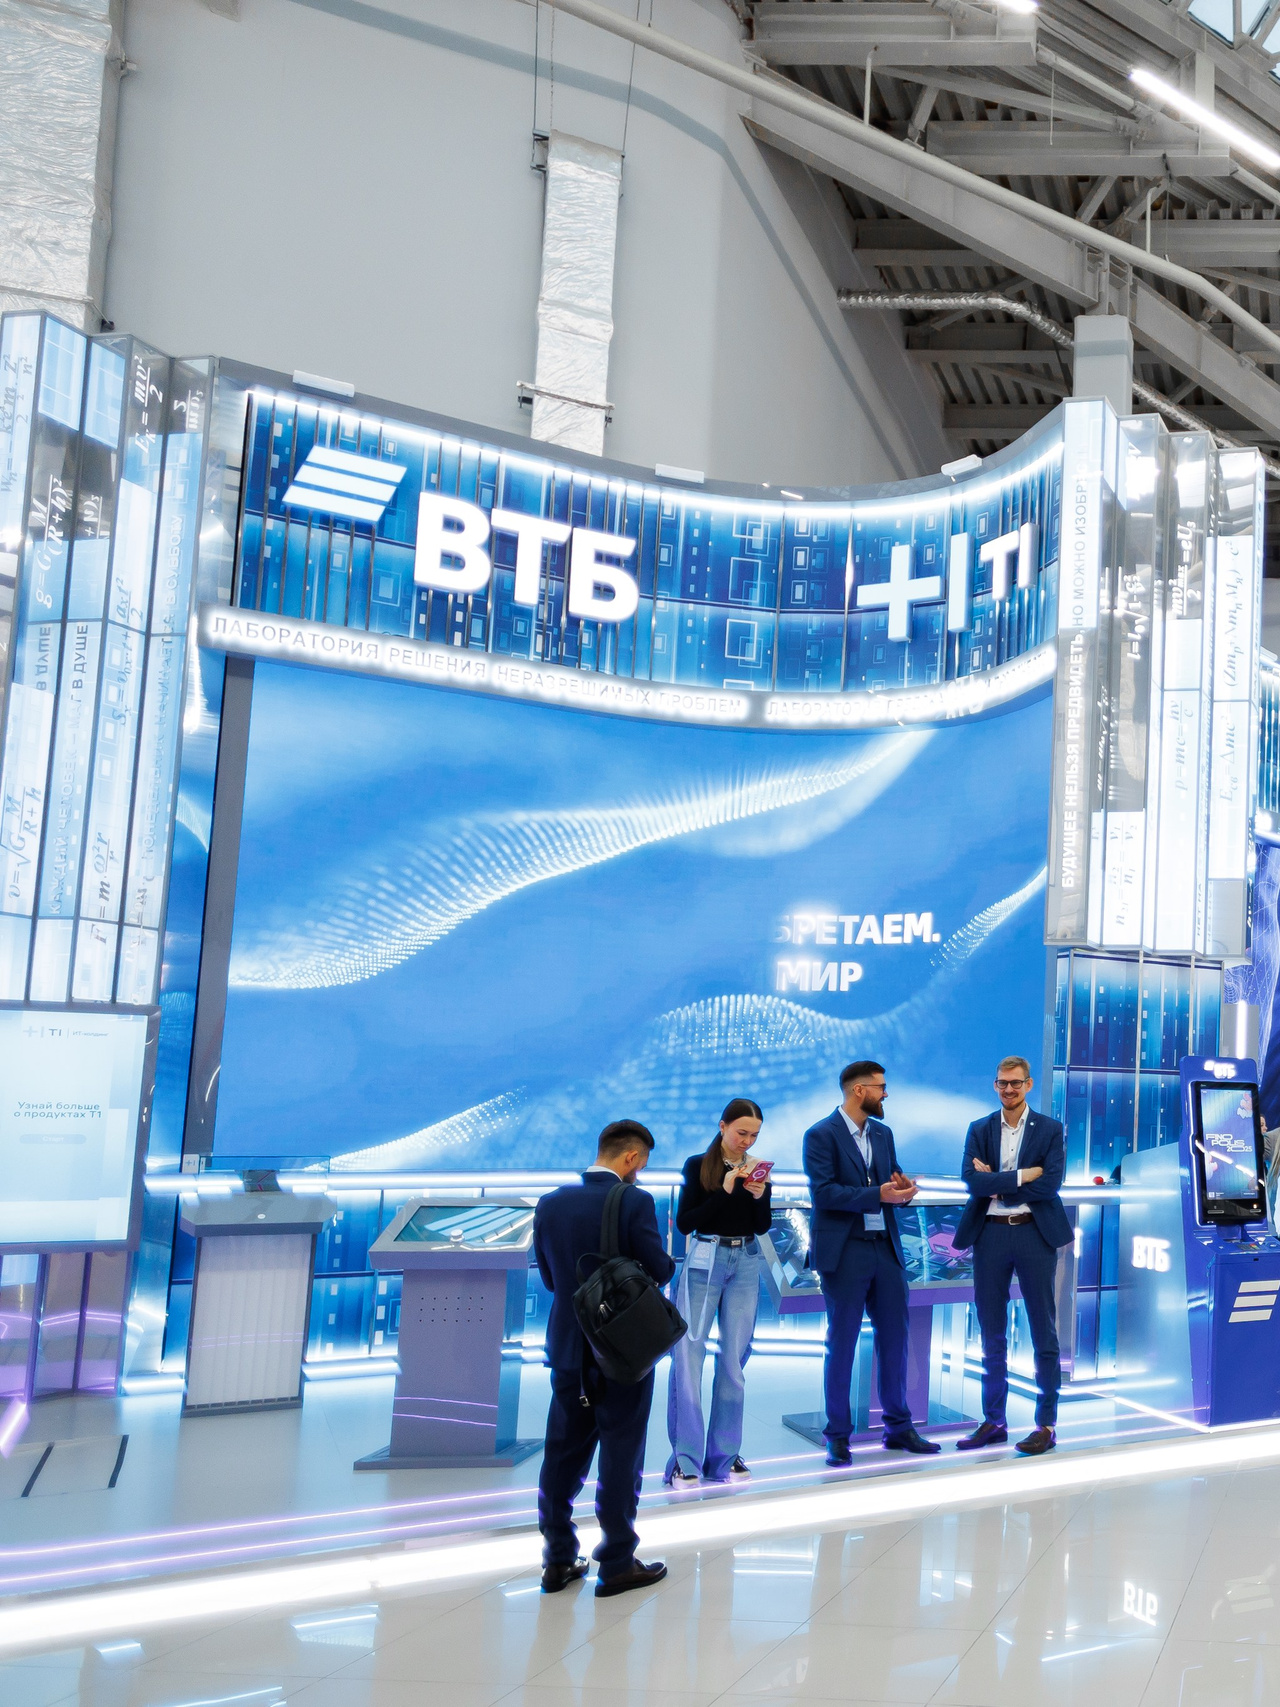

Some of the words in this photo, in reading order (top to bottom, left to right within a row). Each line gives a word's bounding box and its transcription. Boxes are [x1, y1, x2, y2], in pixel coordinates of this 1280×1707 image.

[166, 514, 183, 591] СУББОТУ
[413, 490, 640, 625] ВТБ
[1072, 541, 1086, 602] МОЖНО
[1071, 605, 1085, 627] НО
[73, 624, 89, 674] ДУШЕ
[211, 616, 379, 661] ЛАБОРАТОРИЯ
[389, 648, 487, 679] РЕШЕНИЯ
[497, 665, 652, 706] НЕРАЗРЕШИМЫХ
[72, 678, 83, 690] В
[1066, 628, 1087, 745] ПРЕДВИДЕТЬ,
[1063, 748, 1082, 806] НЕЛЬЗЯ
[1061, 807, 1080, 889] БУДУЩЕЕ
[776, 960, 863, 992] МИР
[1214, 1062, 1237, 1079] ВТБ
[17, 1101, 53, 1112] Узнай
[56, 1101, 101, 1111] больше
[23, 1110, 87, 1120] продуктах
[1205, 1133, 1233, 1141] FINO
[1211, 1139, 1246, 1147] POLIS
[1226, 1145, 1253, 1153] 2025
[1132, 1235, 1171, 1273] ВТБ
